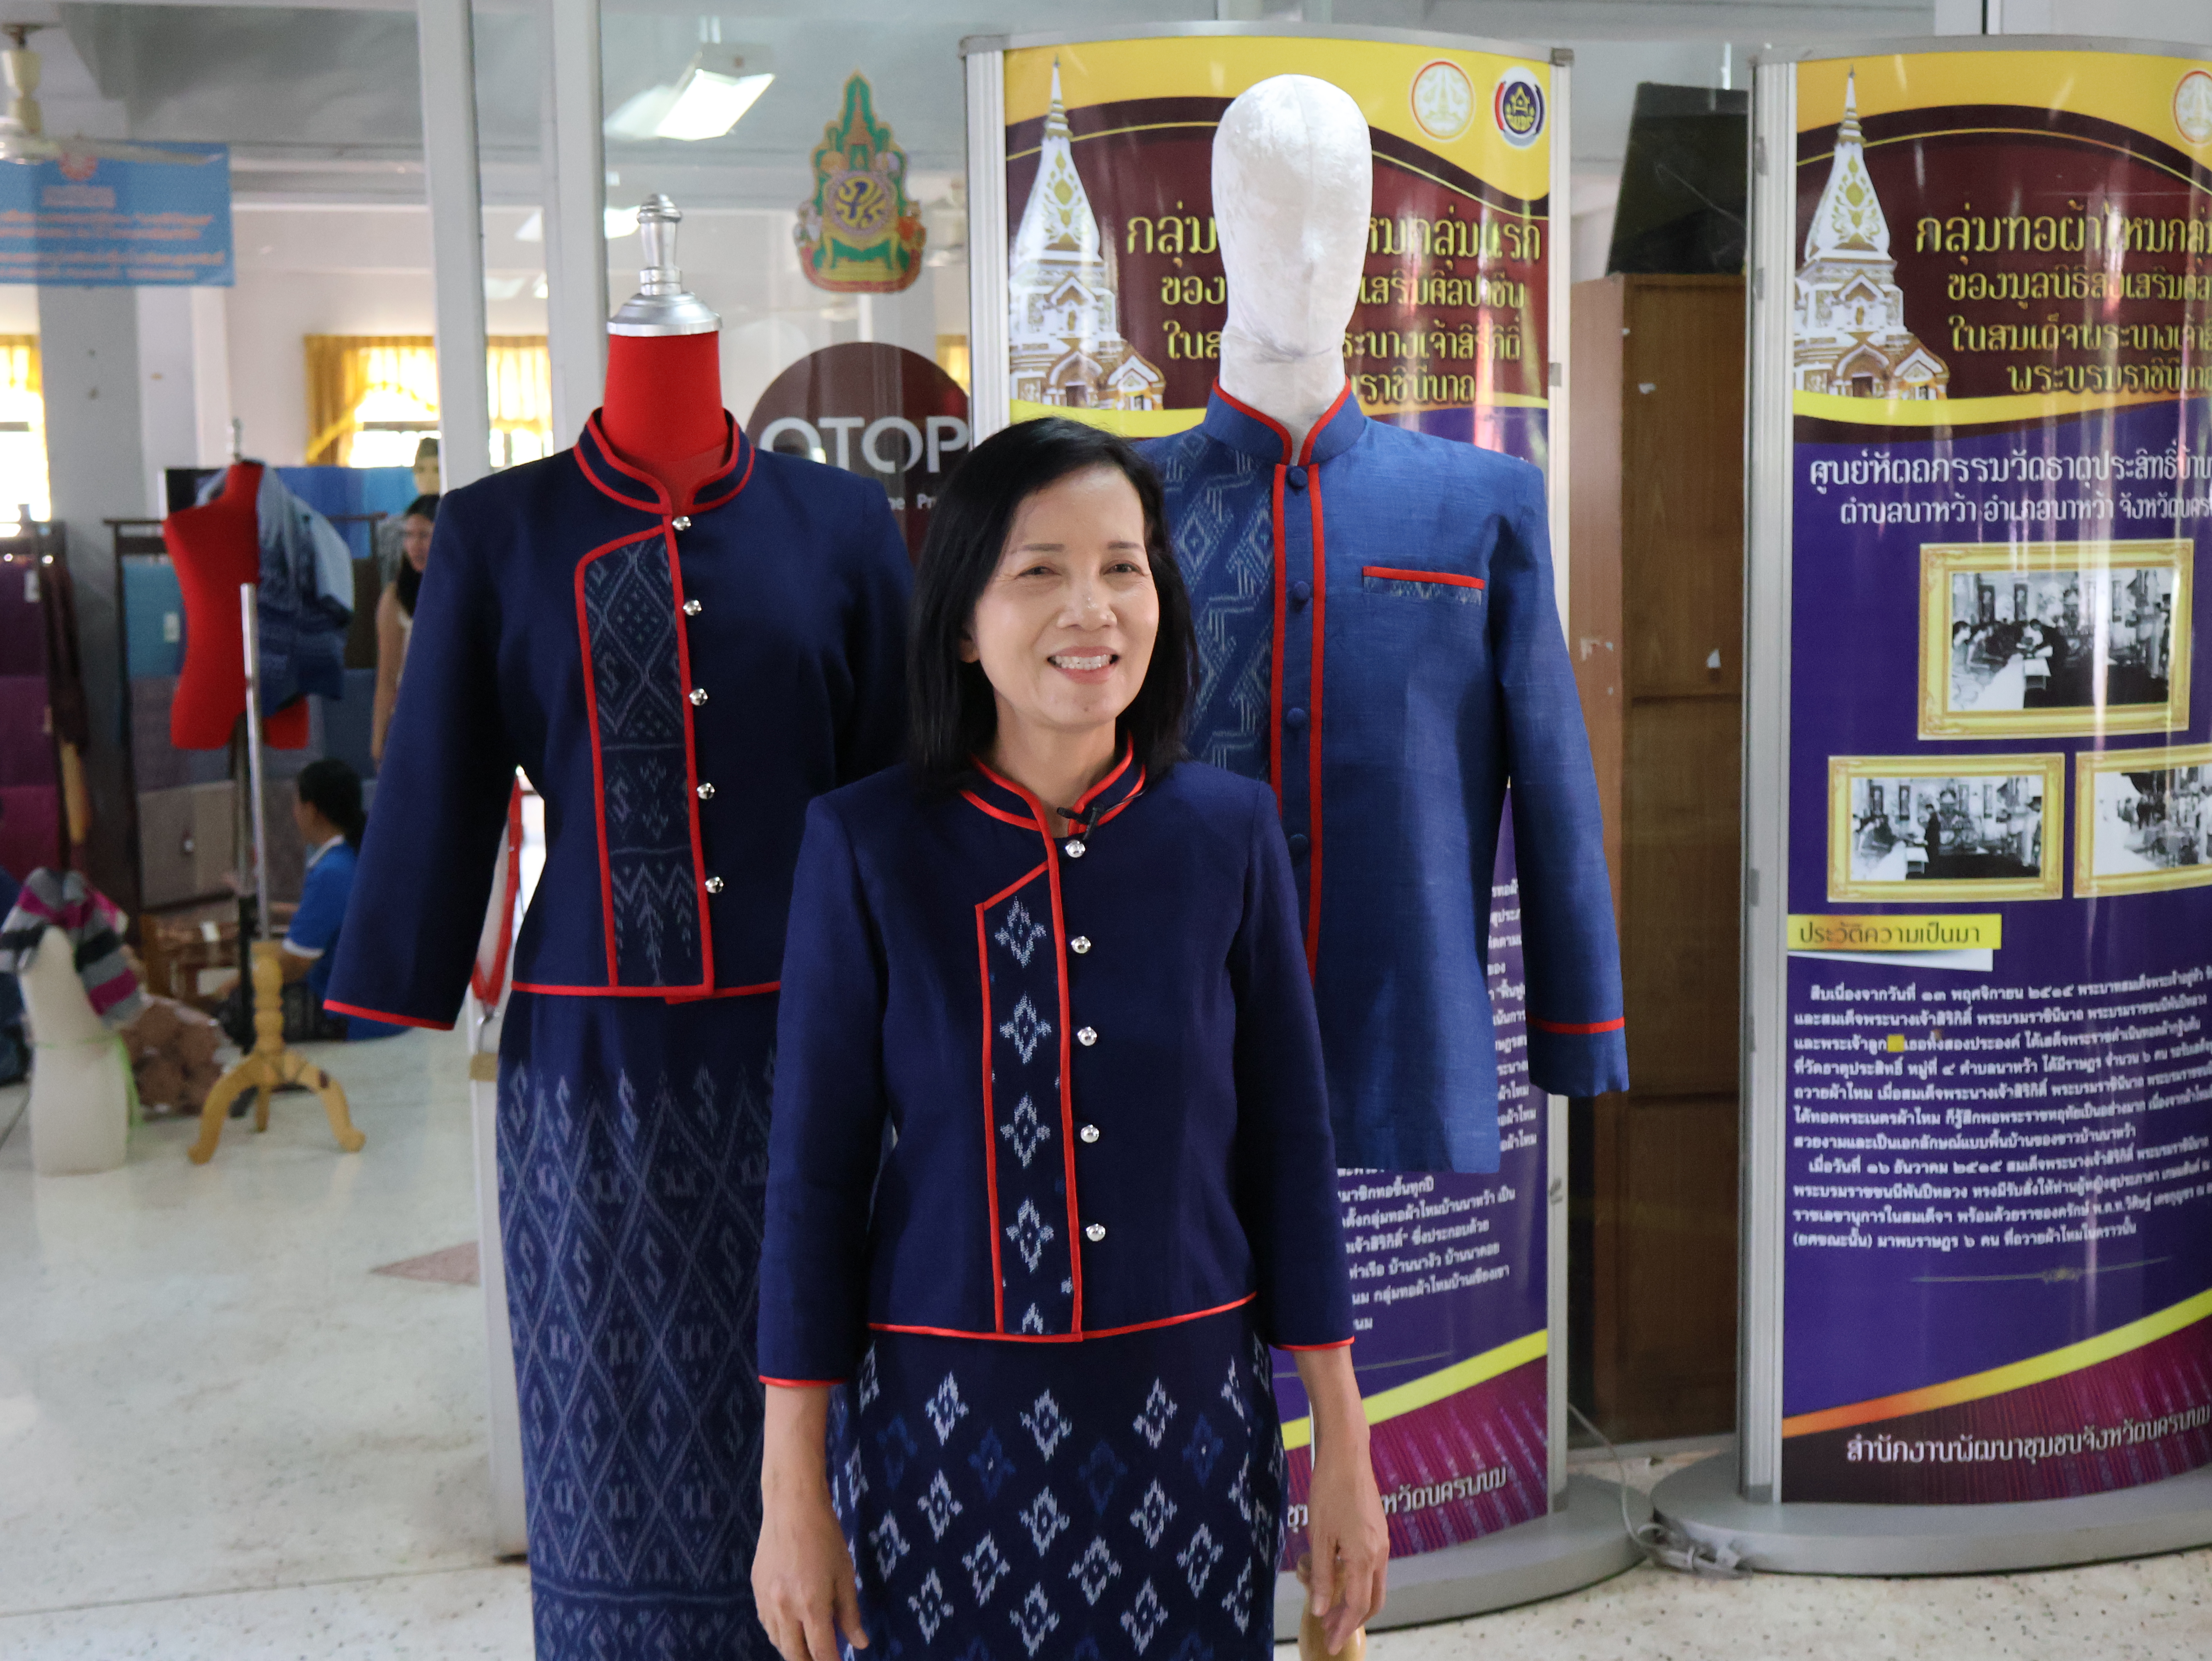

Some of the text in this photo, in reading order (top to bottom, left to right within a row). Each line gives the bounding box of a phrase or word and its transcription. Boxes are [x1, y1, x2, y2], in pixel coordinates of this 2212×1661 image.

[759, 416, 970, 473] OTOP
[1840, 496, 1977, 524] ตำบลนาหว้า
[2119, 491, 2212, 519] จังหวัดนคร
[1800, 921, 1980, 944] ประวัติความเป็นมา
